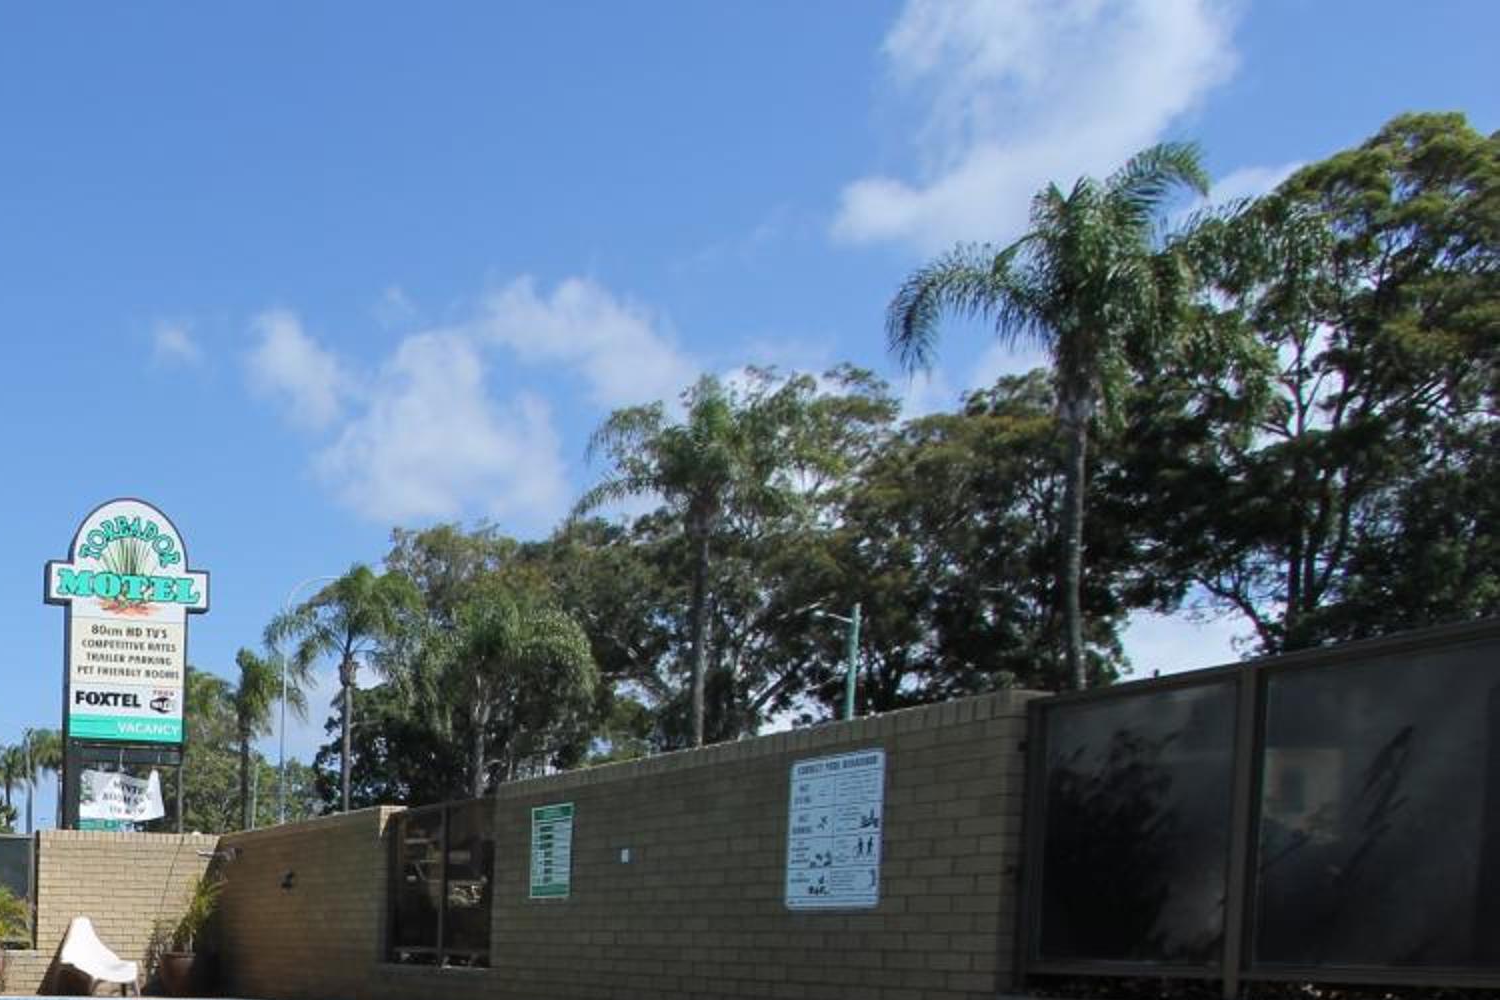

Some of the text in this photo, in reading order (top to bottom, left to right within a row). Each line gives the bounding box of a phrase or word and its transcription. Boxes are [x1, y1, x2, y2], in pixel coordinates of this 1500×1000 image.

[80, 516, 180, 568] TOREADOR
[57, 569, 200, 603] MOTEL
[91, 624, 123, 637] 80cm
[126, 628, 143, 637] HD
[81, 639, 177, 653] COMPETITIVE RATES
[86, 652, 172, 666] TRAILER PARKING
[77, 665, 180, 680] PET FRIENDLY ROOMS
[75, 690, 141, 708] FOXTEL
[117, 721, 181, 735] VACANCY
